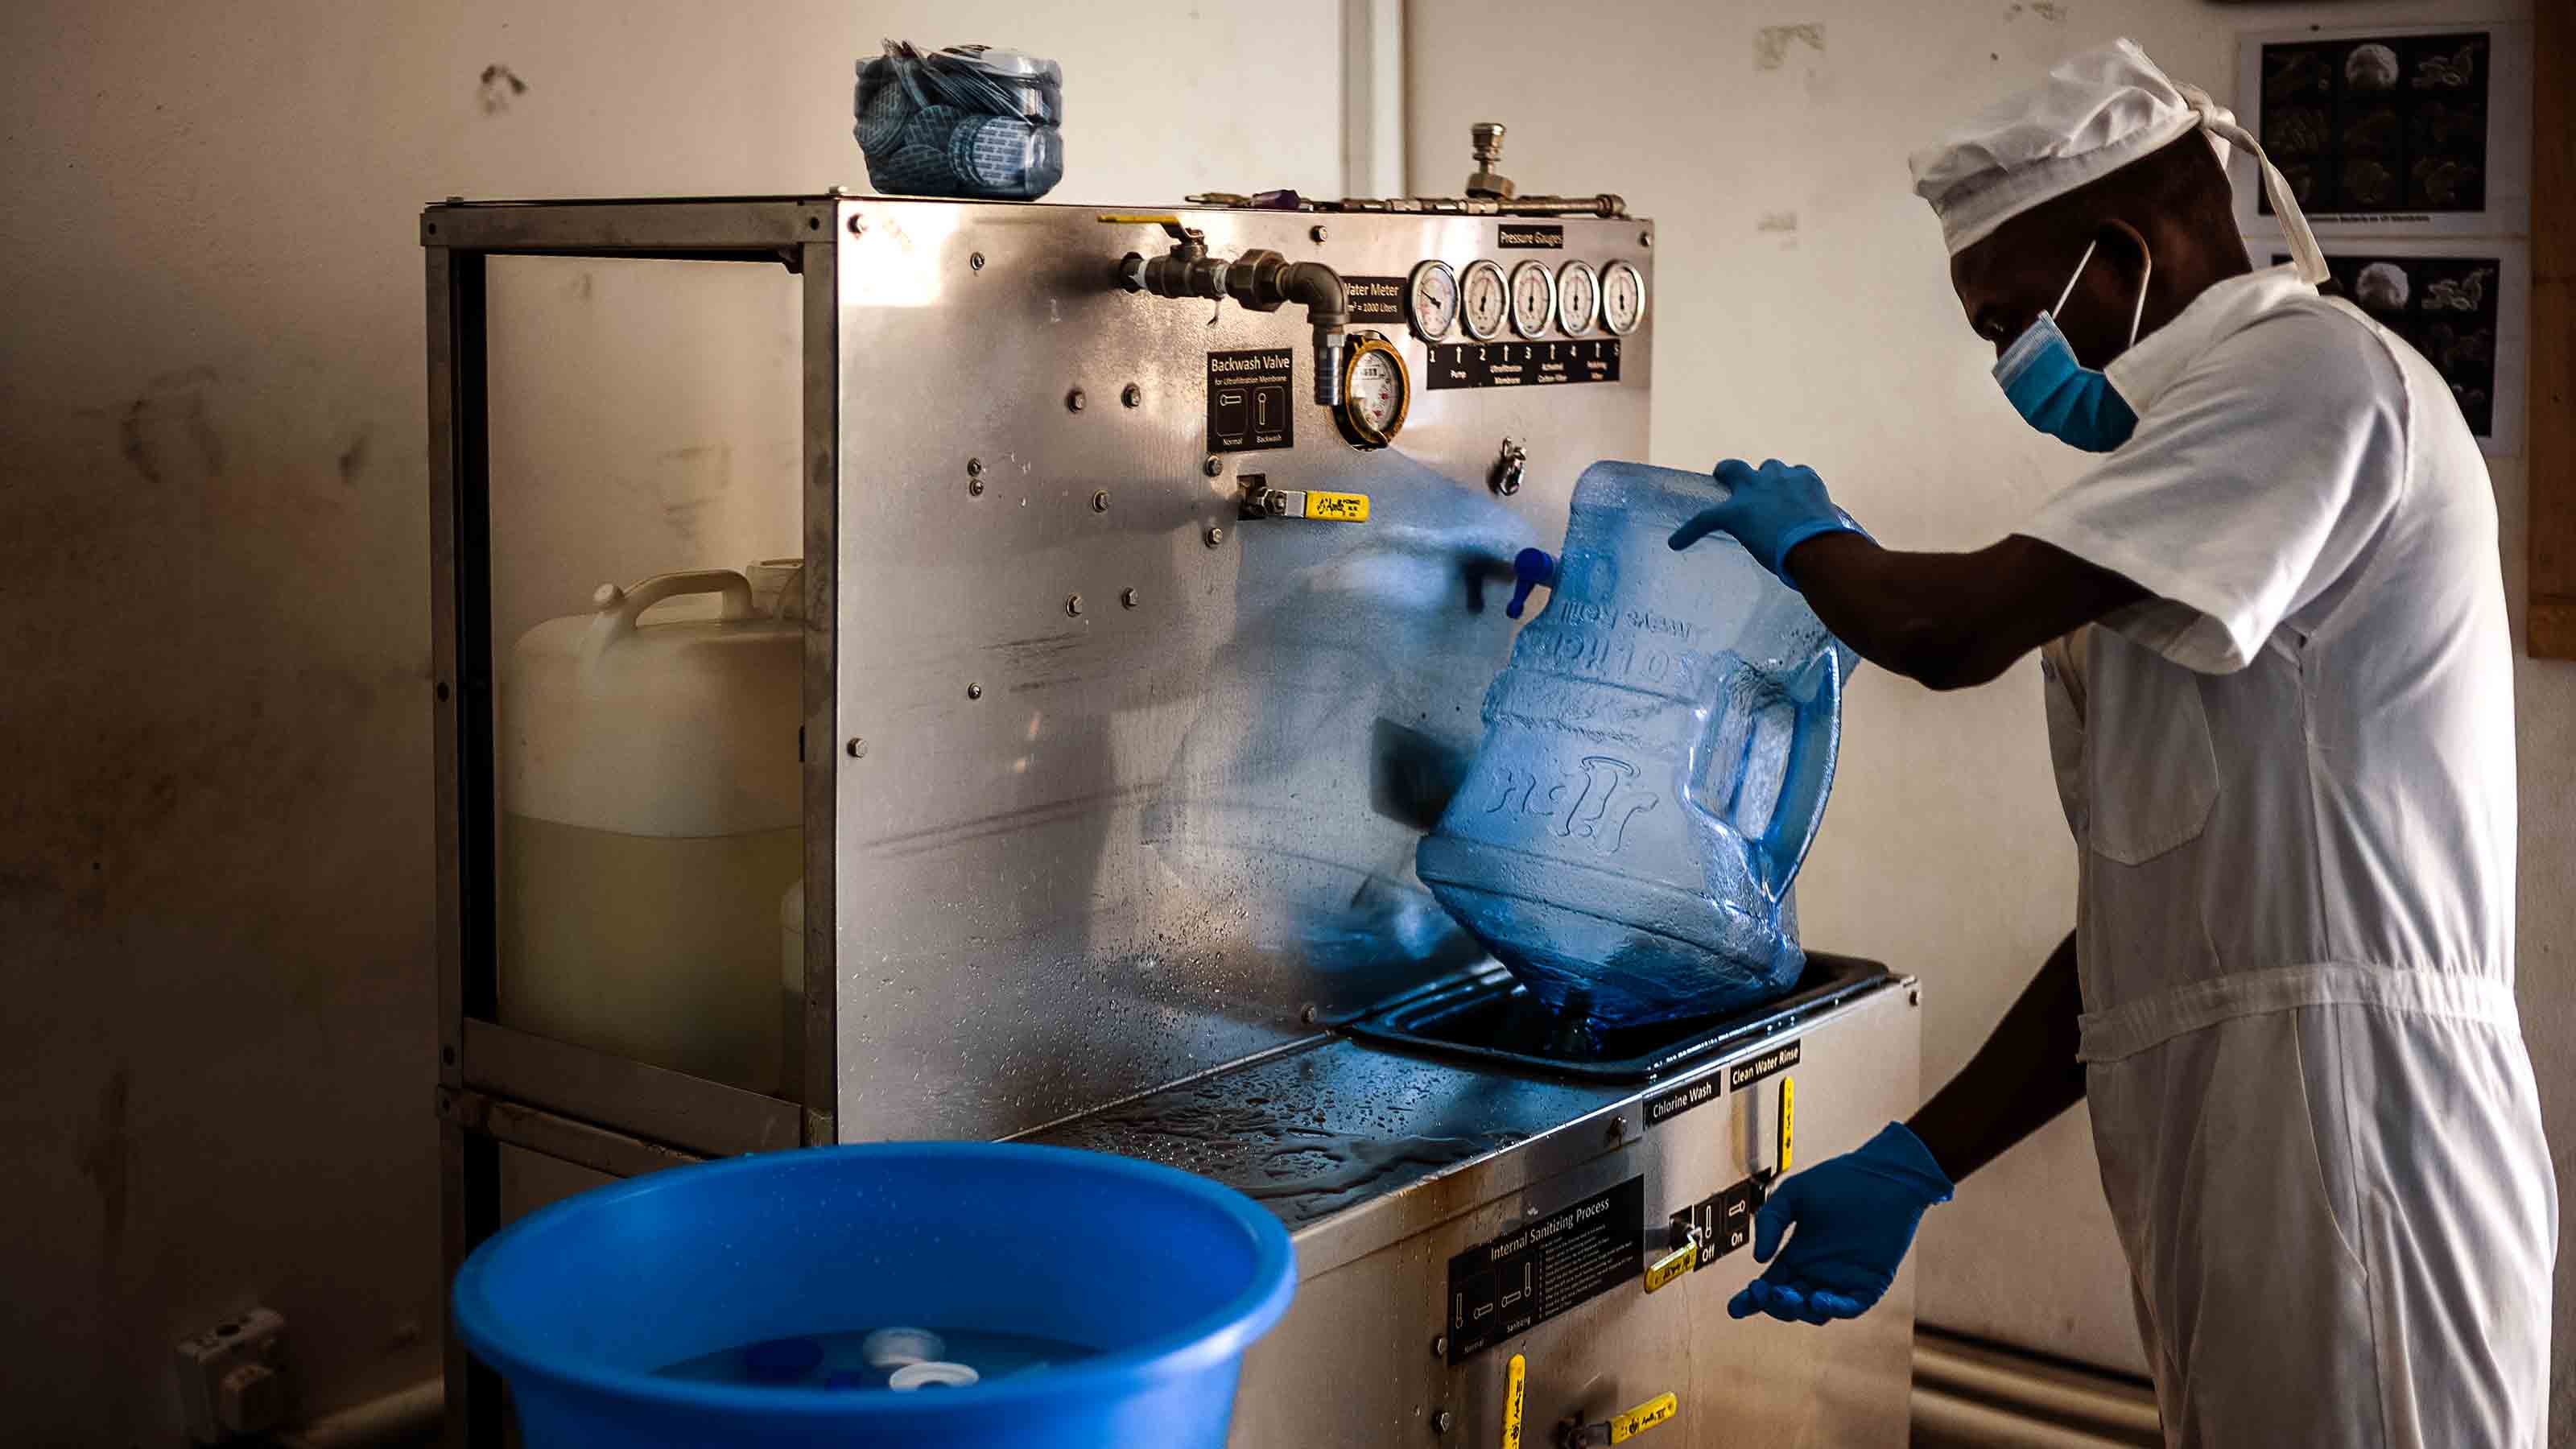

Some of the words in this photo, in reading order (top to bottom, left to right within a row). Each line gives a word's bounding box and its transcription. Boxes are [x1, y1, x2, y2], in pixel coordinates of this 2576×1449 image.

[1501, 231, 1534, 244] Pressure
[1535, 231, 1563, 247] Gauges
[1370, 283, 1399, 296] Meter
[1364, 303, 1379, 312] 1000
[1380, 303, 1398, 313] Liters
[1429, 349, 1436, 362] 1
[1479, 348, 1487, 361] 2
[1525, 346, 1532, 360] 3
[1570, 345, 1577, 357] 4
[1211, 355, 1261, 373] Backwash
[1262, 354, 1290, 370] Valve
[1214, 378, 1223, 386] for
[1223, 437, 1243, 446] Normal
[1256, 434, 1282, 444] Backwash
[1732, 1066, 1753, 1085] Clean
[1755, 1056, 1777, 1075] Water
[1779, 1047, 1799, 1066] Rinse
[1652, 1092, 1688, 1118] Chlorine
[1689, 1081, 1712, 1103] Wash
[1491, 1231, 1529, 1262] Internal
[1530, 1213, 1574, 1244] Sanitizing
[1575, 1198, 1610, 1223] Process
[1731, 1232, 1744, 1247] On
[1702, 1242, 1715, 1262] Off
[1507, 1315, 1531, 1333] Sanitizing
